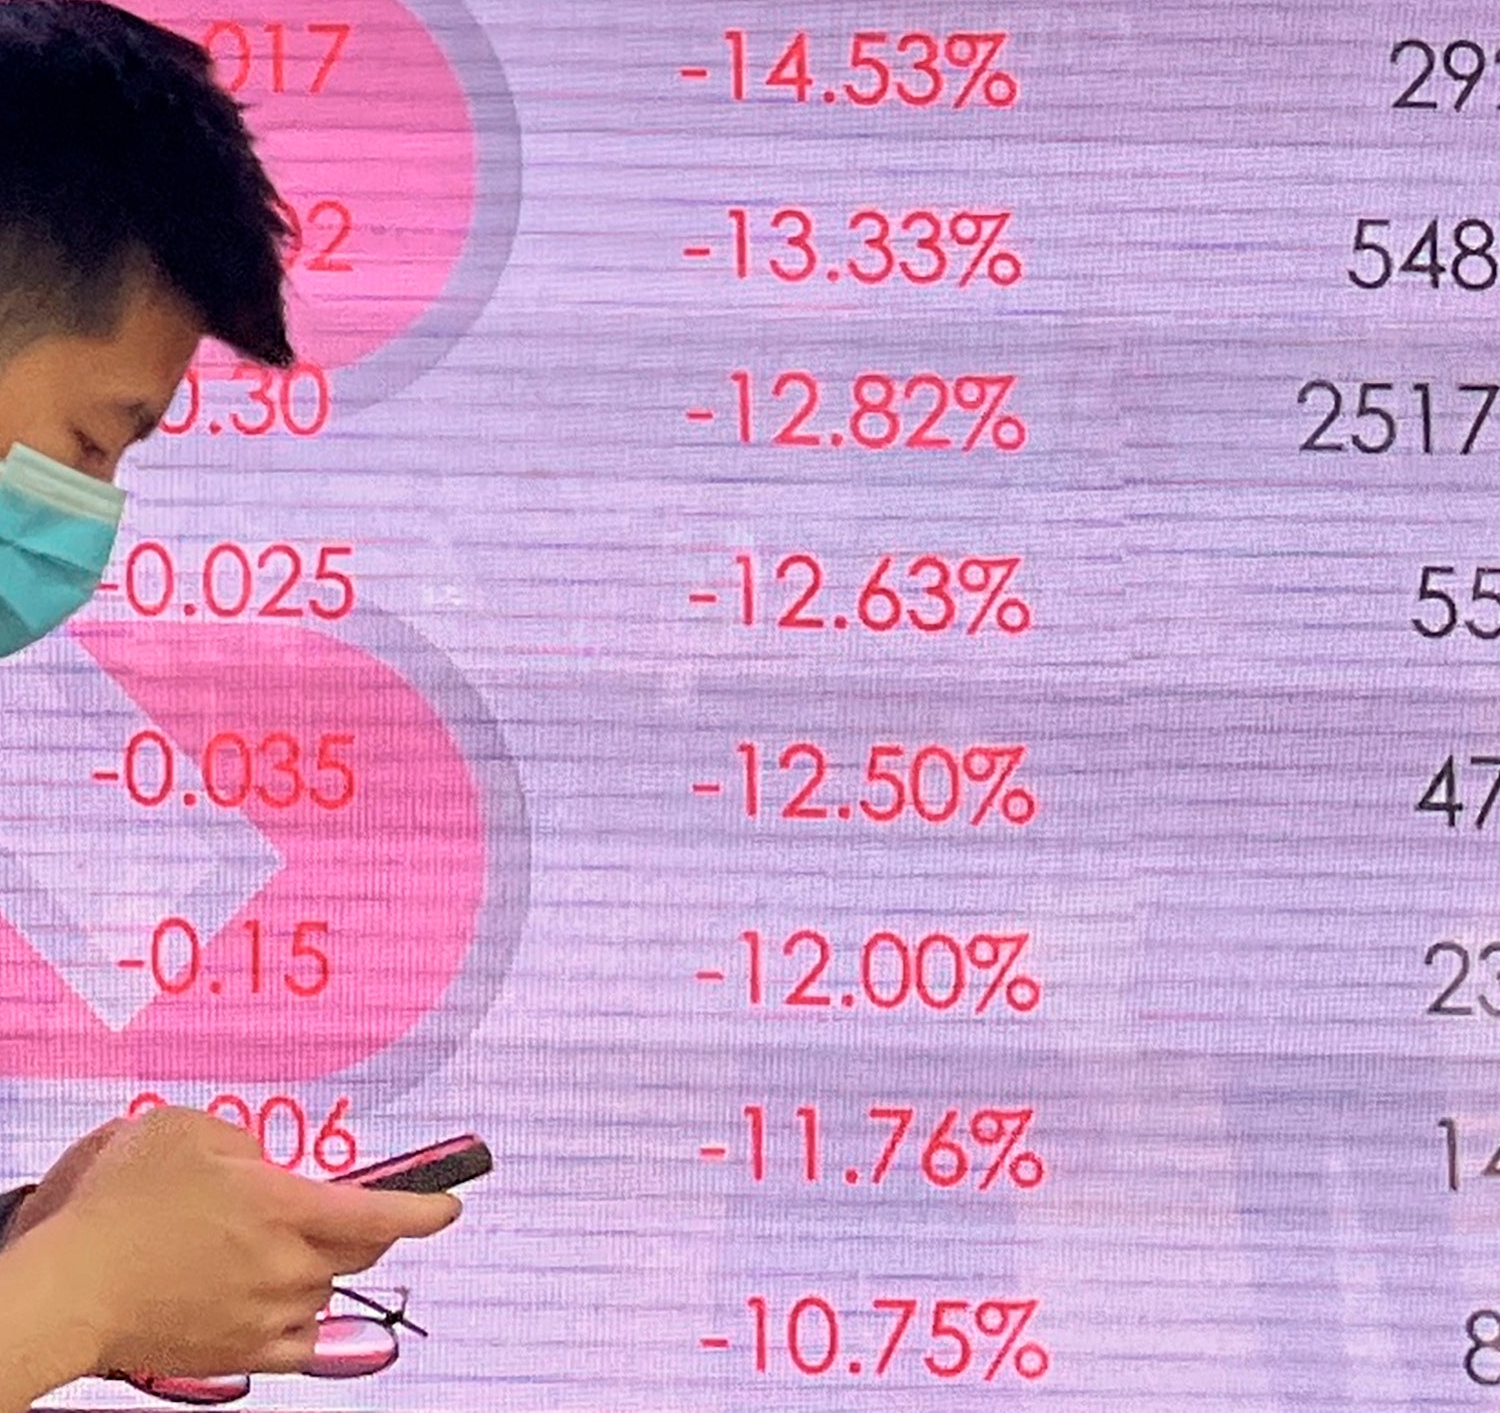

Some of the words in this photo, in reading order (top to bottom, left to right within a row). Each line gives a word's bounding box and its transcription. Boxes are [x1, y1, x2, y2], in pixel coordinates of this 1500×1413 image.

[682, 30, 1018, 108] -14.53%
[685, 208, 1023, 287] -13.33%
[688, 371, 1027, 451] -12.82%
[96, 541, 358, 622] -0.025
[692, 553, 1031, 635] -12.63%
[89, 729, 362, 814] -0.035
[696, 742, 1038, 826] -12.50%
[115, 915, 334, 1000] -0.15
[700, 929, 1041, 1013] -12.00%
[702, 1105, 1047, 1190] -11.76%
[702, 1295, 1050, 1381] -10.75%
